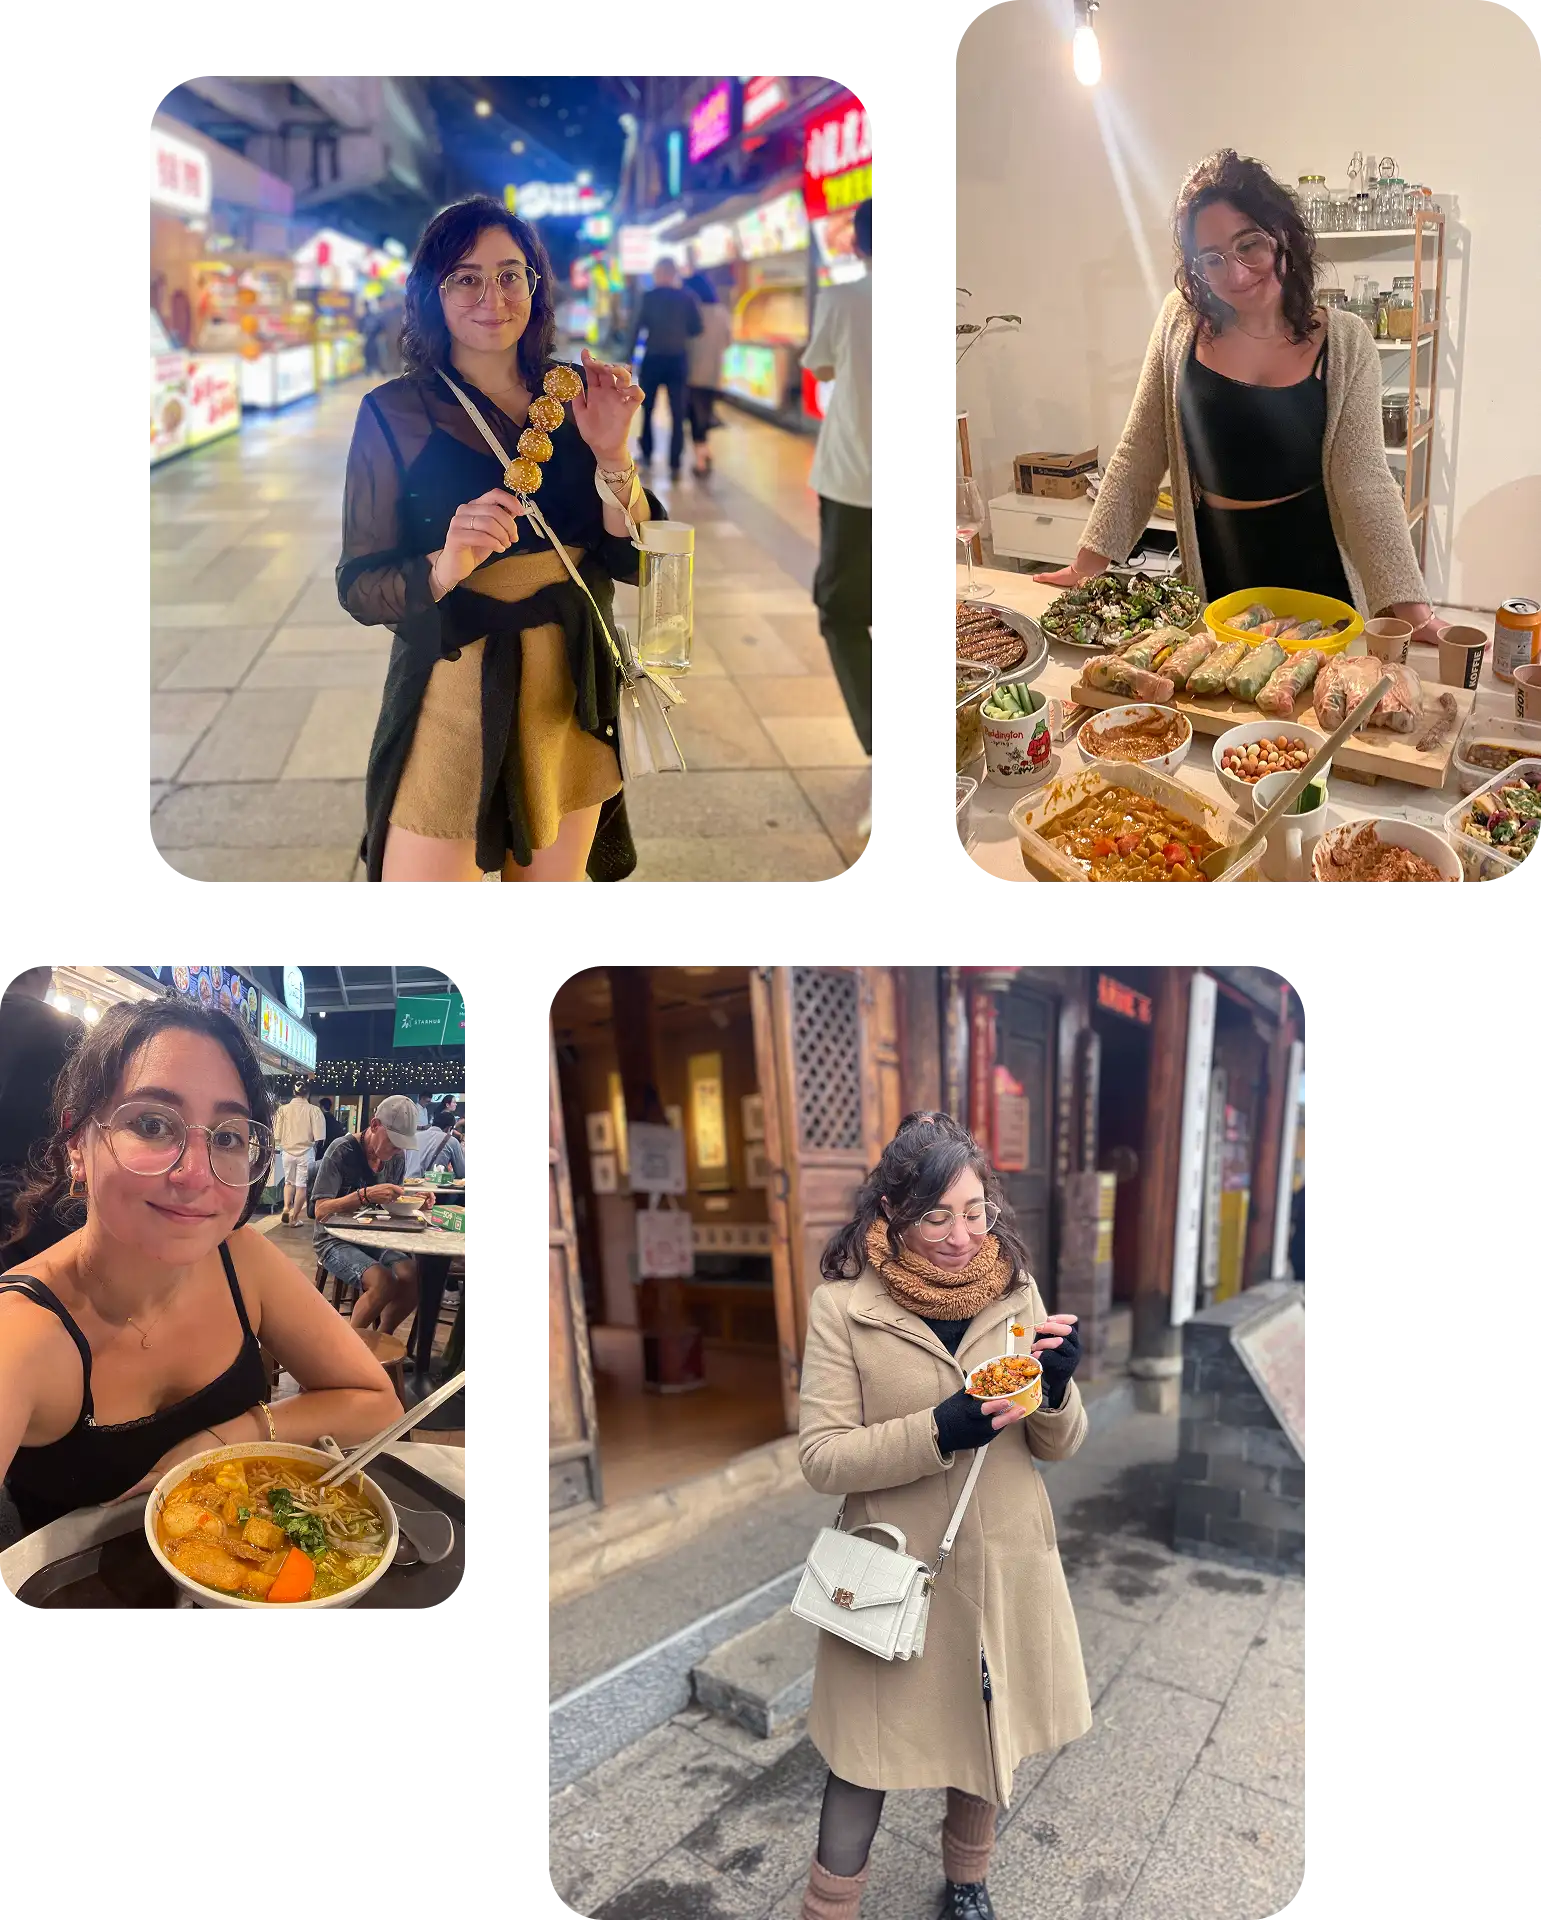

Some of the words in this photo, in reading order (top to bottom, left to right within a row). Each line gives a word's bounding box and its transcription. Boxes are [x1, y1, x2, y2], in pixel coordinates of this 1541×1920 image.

[1468, 650, 1482, 687] KOFFIE
[1517, 687, 1525, 718] KOFF
[984, 725, 1024, 741] Paddington
